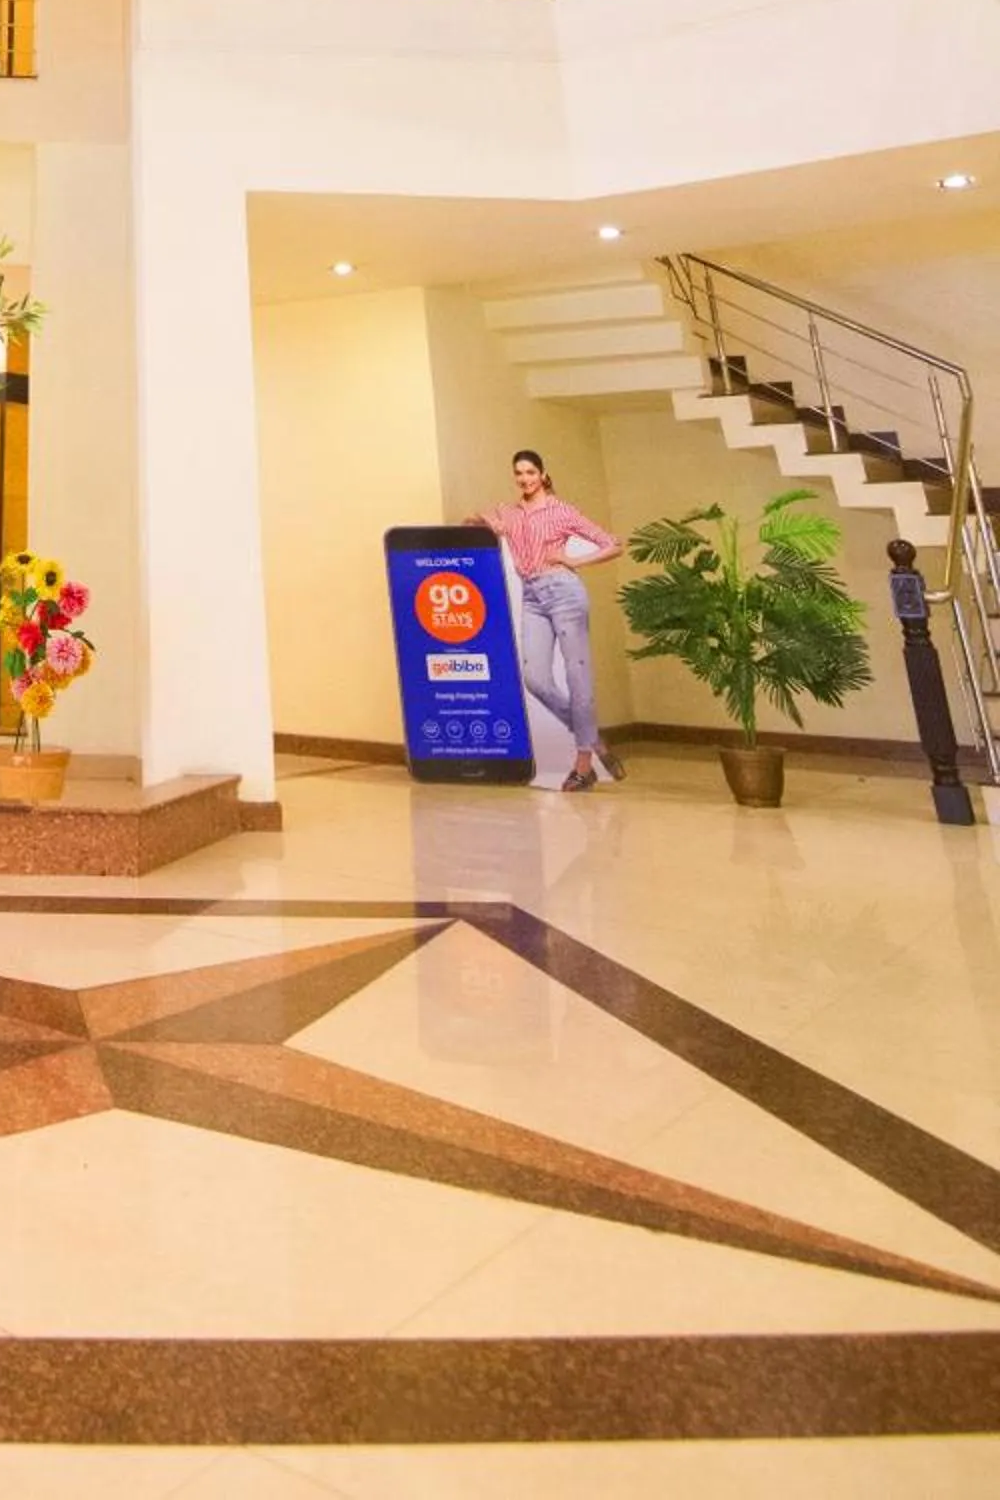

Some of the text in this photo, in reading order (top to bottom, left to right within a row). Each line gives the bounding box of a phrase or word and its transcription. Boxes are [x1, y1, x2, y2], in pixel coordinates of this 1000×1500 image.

[415, 557, 460, 567] WELCOME
[429, 583, 469, 612] go
[432, 612, 473, 628] STAYS
